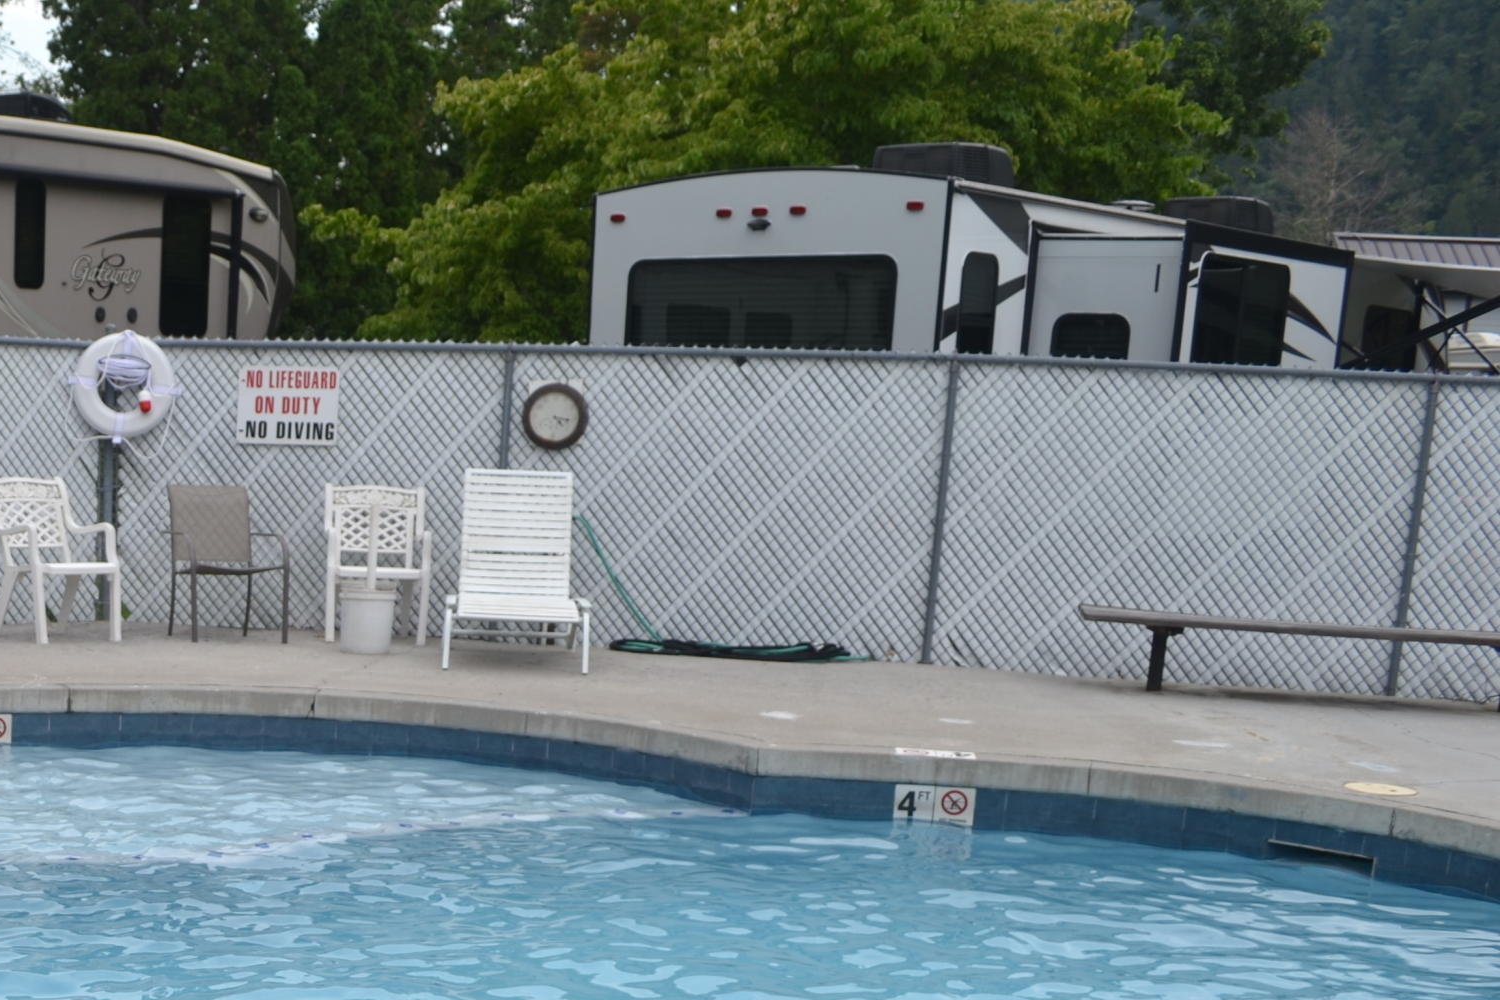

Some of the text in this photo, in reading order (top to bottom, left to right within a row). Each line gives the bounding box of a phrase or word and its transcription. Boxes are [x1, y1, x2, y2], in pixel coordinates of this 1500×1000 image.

[70, 255, 141, 293] Gateway
[269, 370, 337, 389] LIFEGUARD
[255, 396, 320, 415] ON DUTY
[276, 421, 335, 440] DIVING
[898, 791, 931, 816] 4 FT
